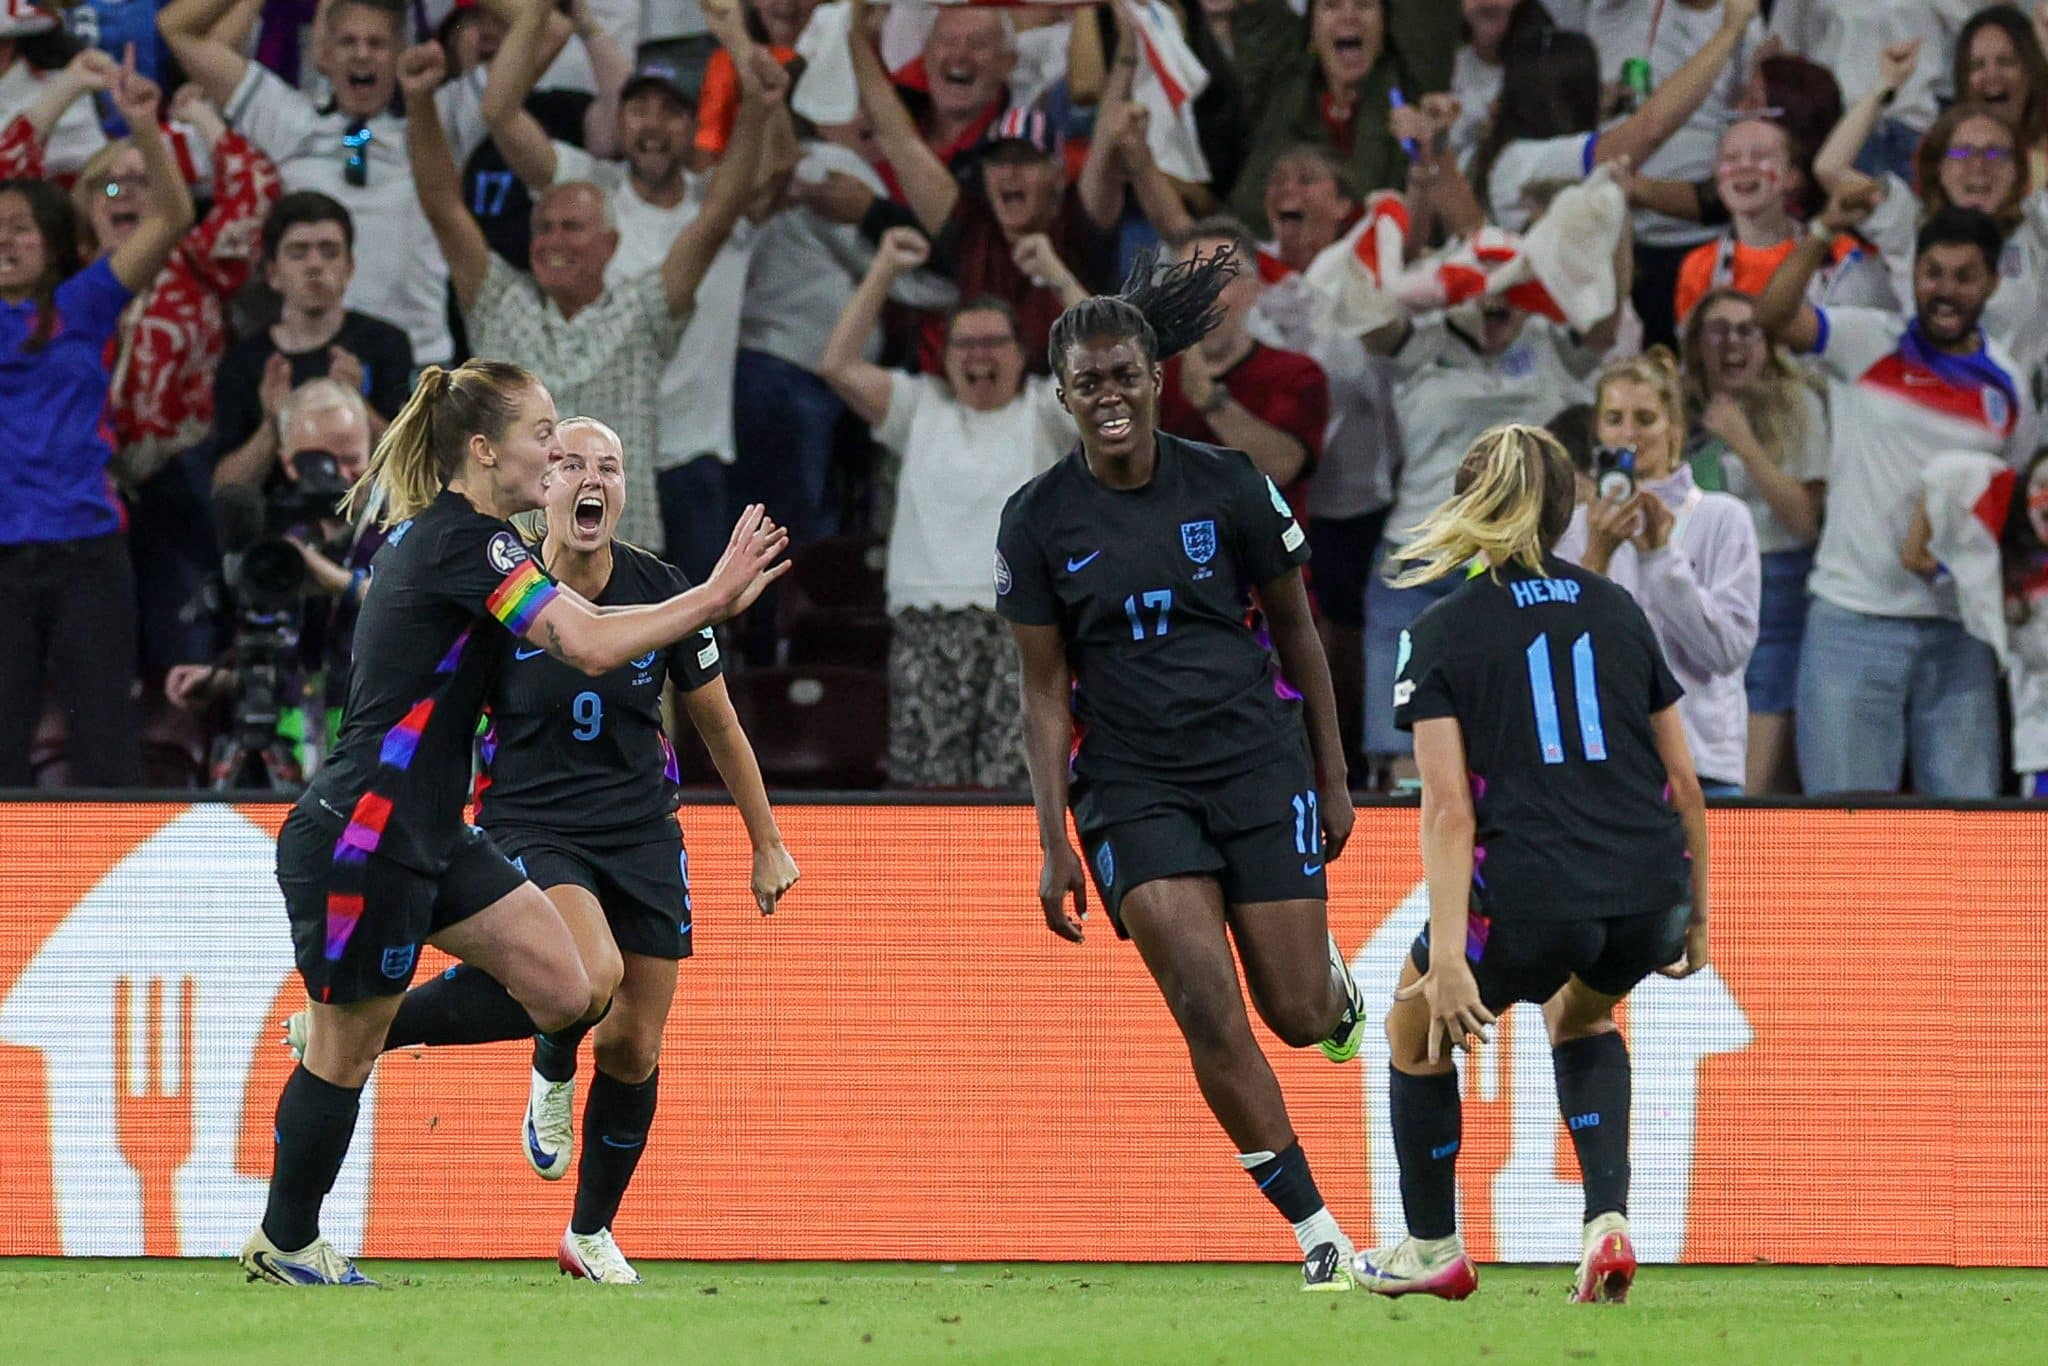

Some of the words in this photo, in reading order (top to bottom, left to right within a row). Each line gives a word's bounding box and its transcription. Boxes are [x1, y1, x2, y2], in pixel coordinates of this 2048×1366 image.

[475, 170, 512, 216] 17
[1124, 589, 1171, 640] 17
[1510, 579, 1581, 608] HEMP
[572, 691, 602, 741] 9
[1526, 631, 1607, 763] 11
[1292, 790, 1318, 854] 17
